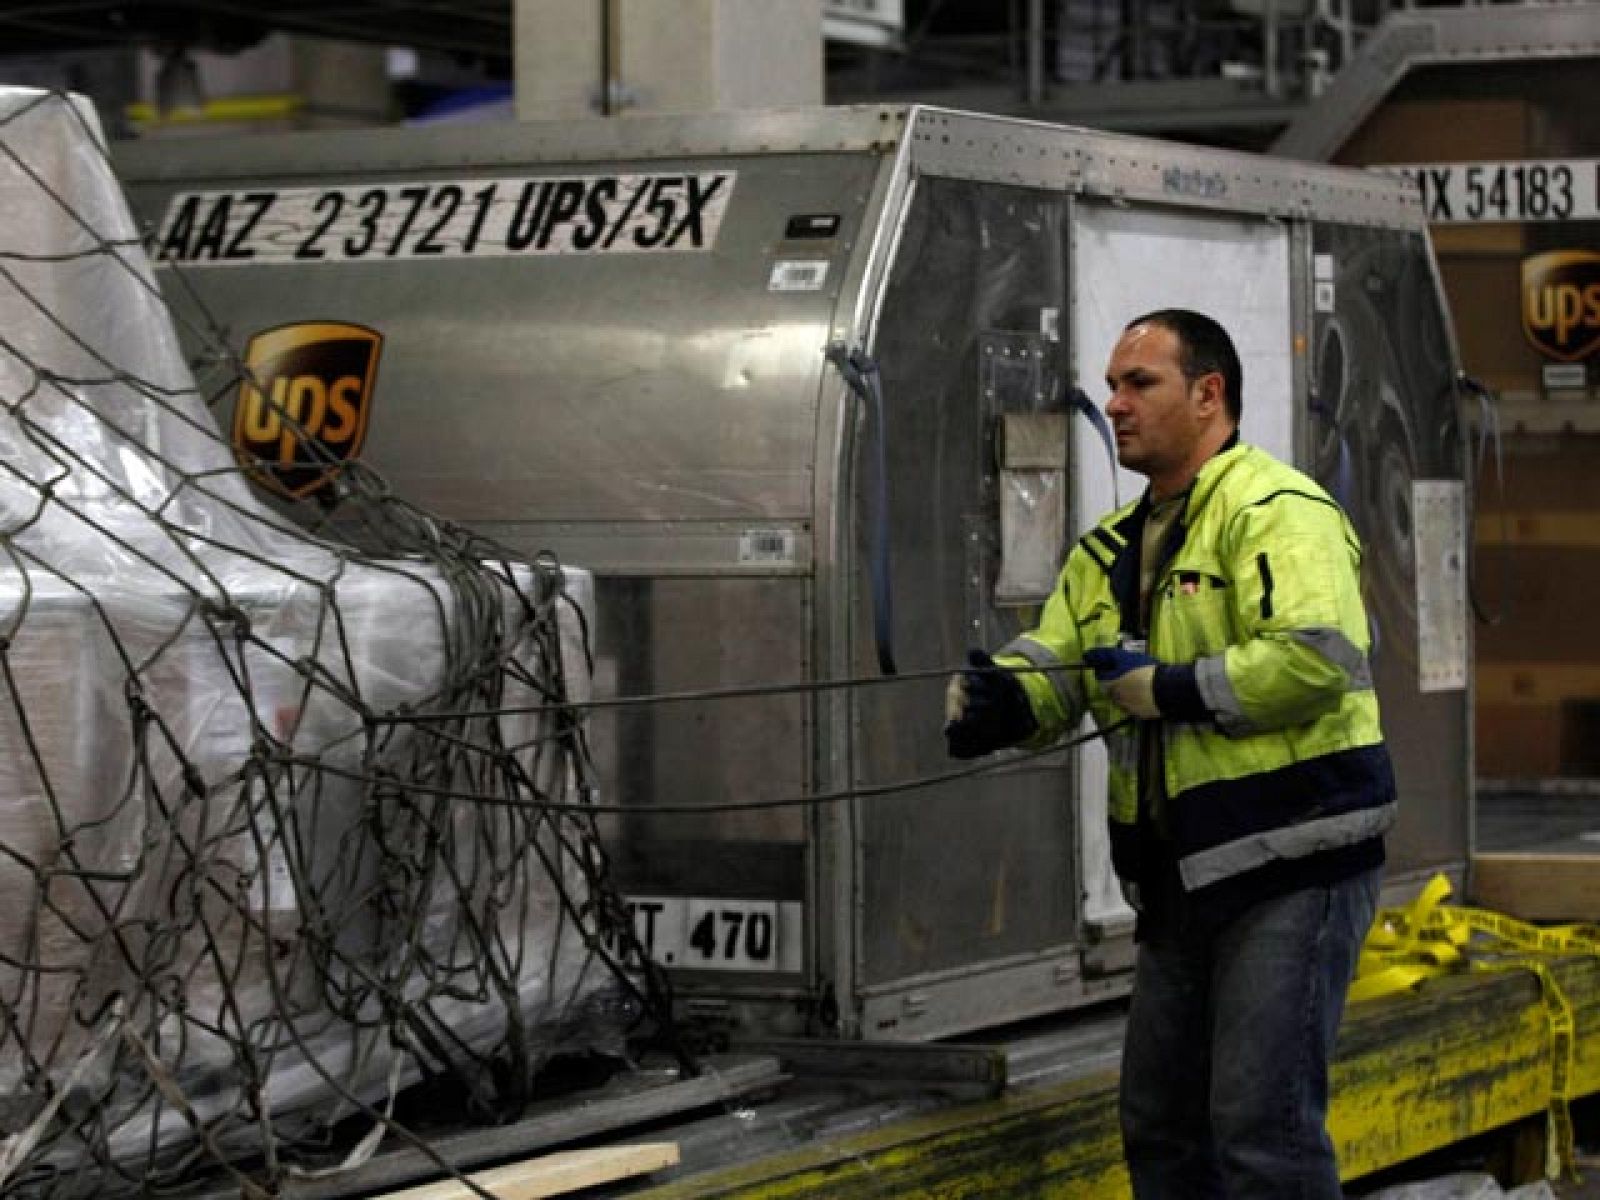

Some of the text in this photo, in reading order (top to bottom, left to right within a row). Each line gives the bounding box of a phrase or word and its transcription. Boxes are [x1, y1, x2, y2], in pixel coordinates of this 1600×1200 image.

[157, 174, 727, 260] AAZ 23721 UPS/5X
[1465, 165, 1573, 218] 54183
[689, 909, 772, 961] 470
